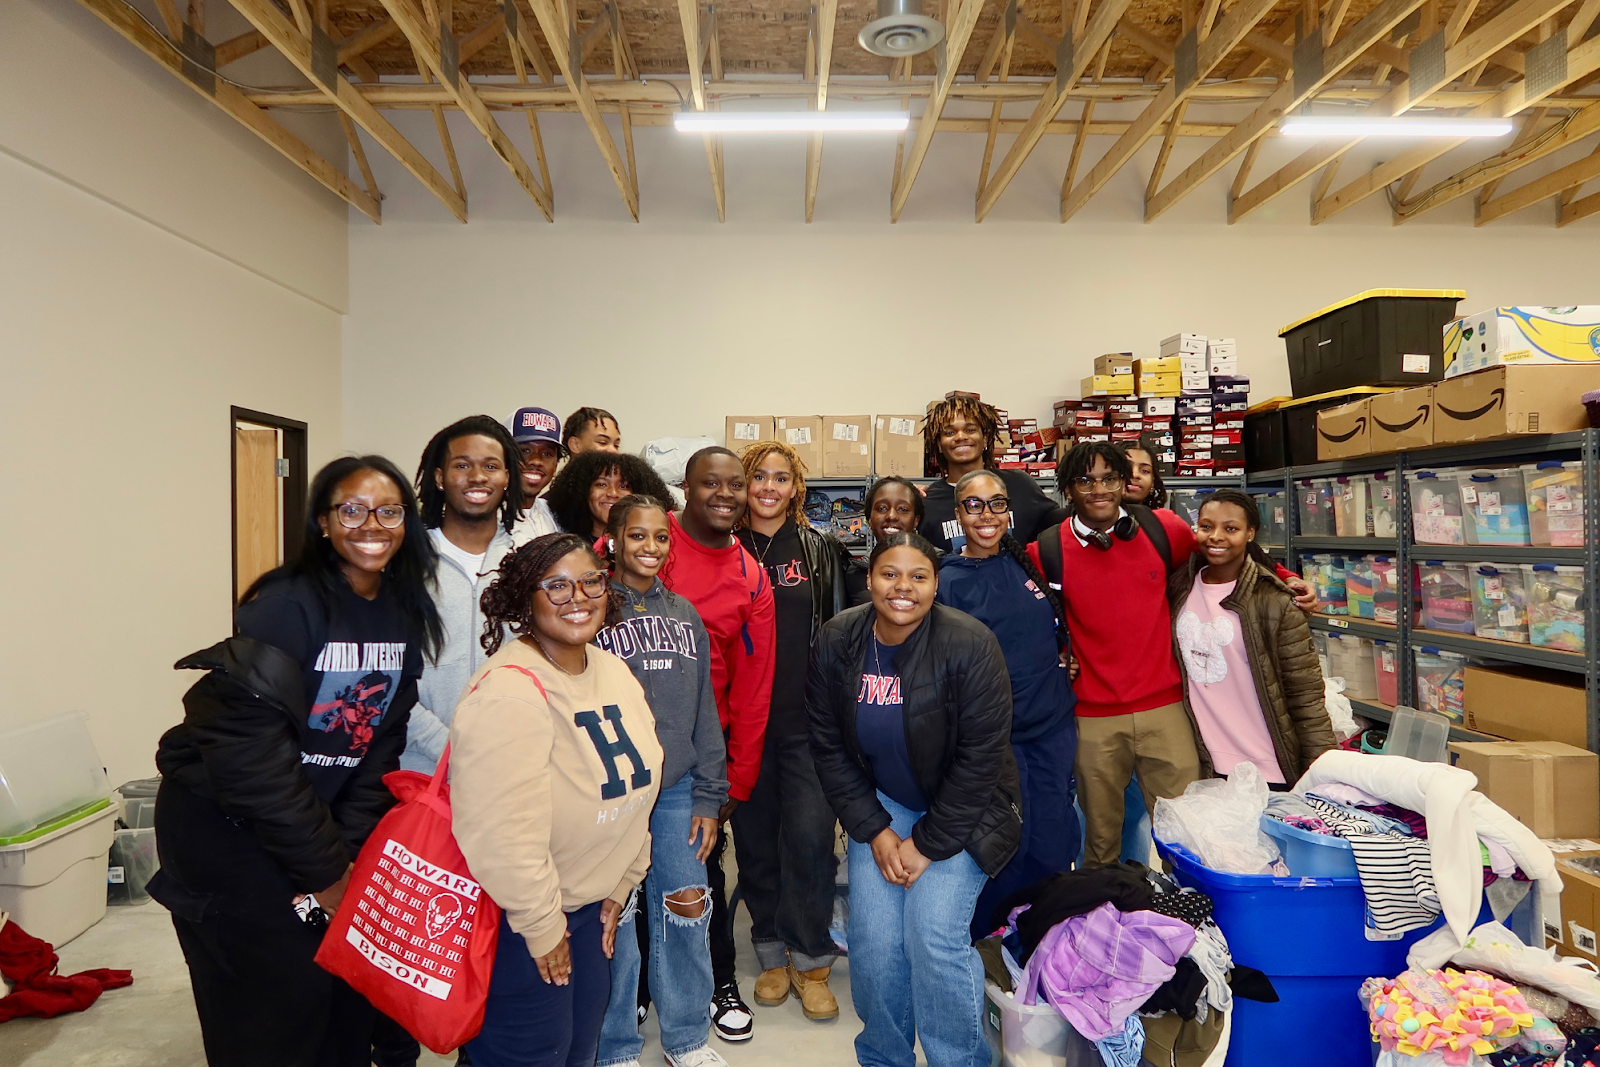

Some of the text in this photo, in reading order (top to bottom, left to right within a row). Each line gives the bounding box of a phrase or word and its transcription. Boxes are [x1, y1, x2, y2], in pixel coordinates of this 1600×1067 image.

[522, 412, 557, 432] HOWARD
[574, 704, 652, 801] H
[371, 871, 385, 886] HU.
[392, 888, 408, 903] HU.
[408, 899, 424, 912] HU.
[378, 858, 392, 872] HU.
[400, 873, 416, 888] HU.
[415, 884, 431, 897] HU.
[357, 899, 463, 963] HU. HU. HU. HU. HU. HU. HU.
[364, 885, 468, 948] HU. HU. HU. HU. HU.
[352, 913, 456, 979] HU. HU. HU. HU. HU. HU. HU.
[359, 939, 428, 989] BISON
